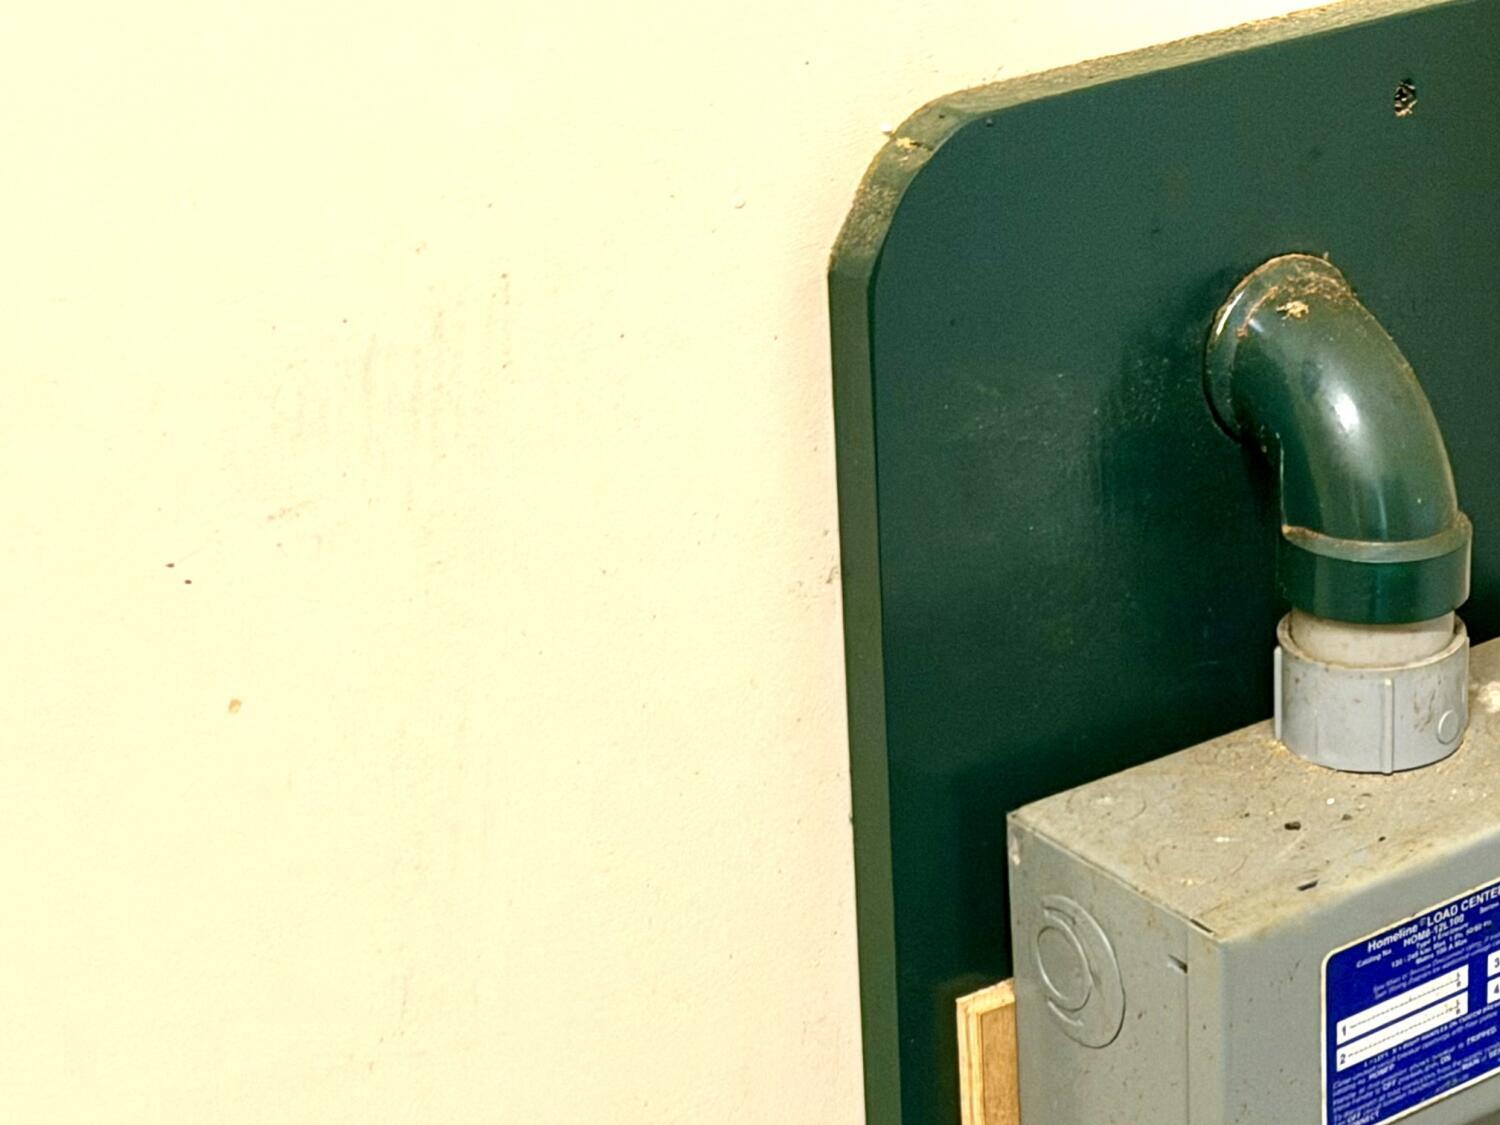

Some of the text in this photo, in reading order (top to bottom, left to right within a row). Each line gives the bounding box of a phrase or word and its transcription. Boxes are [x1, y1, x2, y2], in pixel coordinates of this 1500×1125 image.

[1427, 904, 1458, 928] LOAD
[1494, 957, 1500, 969] 3
[1494, 983, 1500, 994] 4
[1340, 1053, 1347, 1065] 2
